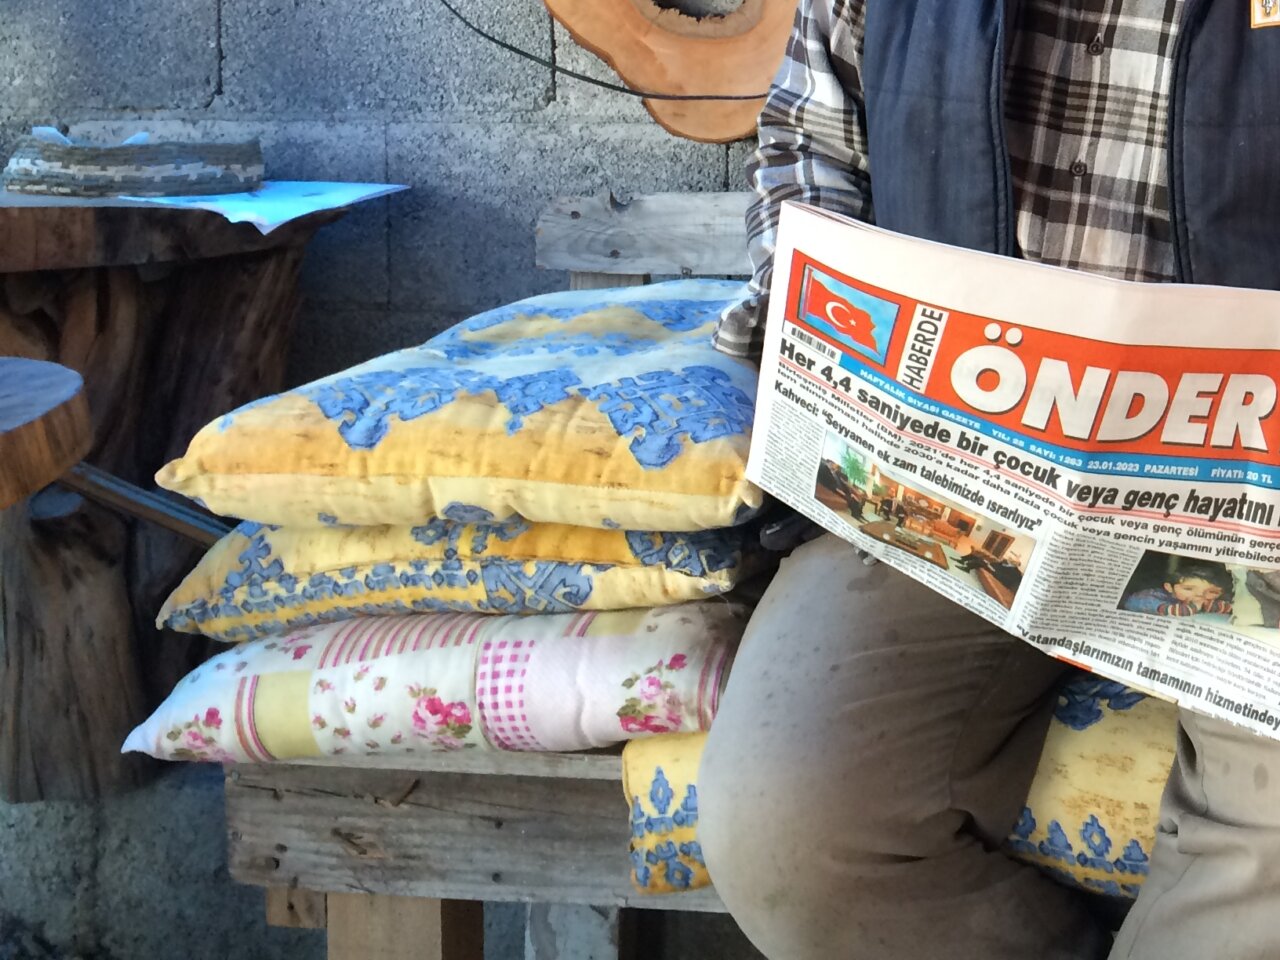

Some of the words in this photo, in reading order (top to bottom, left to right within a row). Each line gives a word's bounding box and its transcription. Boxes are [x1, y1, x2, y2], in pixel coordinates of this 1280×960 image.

[902, 308, 943, 390] HABERDE
[950, 323, 1276, 452] ÖNDER
[775, 380, 819, 417] Kahveci:
[877, 449, 892, 464] ek
[893, 457, 918, 474] zam
[920, 465, 985, 506] talebimizde
[780, 338, 816, 371] Her
[821, 365, 851, 393] 4,4
[857, 388, 951, 443] saniyede
[957, 431, 988, 457] bir
[993, 450, 1061, 489] çocuk
[1066, 480, 1119, 508] veya
[1122, 489, 1179, 518] genç
[1183, 489, 1274, 526] hayatını
[831, 394, 874, 422] Milletler
[960, 458, 979, 470] her
[1004, 480, 1056, 507] saniyede
[1059, 506, 1075, 517] bir
[1078, 513, 1115, 525] çocuk
[1120, 519, 1149, 530] veya
[1153, 523, 1182, 535] genç
[1186, 526, 1245, 544] ölümünün
[860, 369, 905, 399] HAFTALIK
[942, 409, 981, 429] GAZETE
[1087, 461, 1139, 472] 23.01.2023
[1144, 464, 1199, 476] PAZARTESİ
[1261, 474, 1272, 484] TL
[946, 463, 980, 480] kadar
[983, 479, 1011, 496] daha
[1014, 492, 1041, 510] fazla
[1043, 509, 1078, 529] çocuk
[1082, 526, 1110, 537] veya
[1114, 531, 1155, 544] gencin
[1158, 538, 1212, 554] yaşamını
[1137, 661, 1203, 698] tamamının
